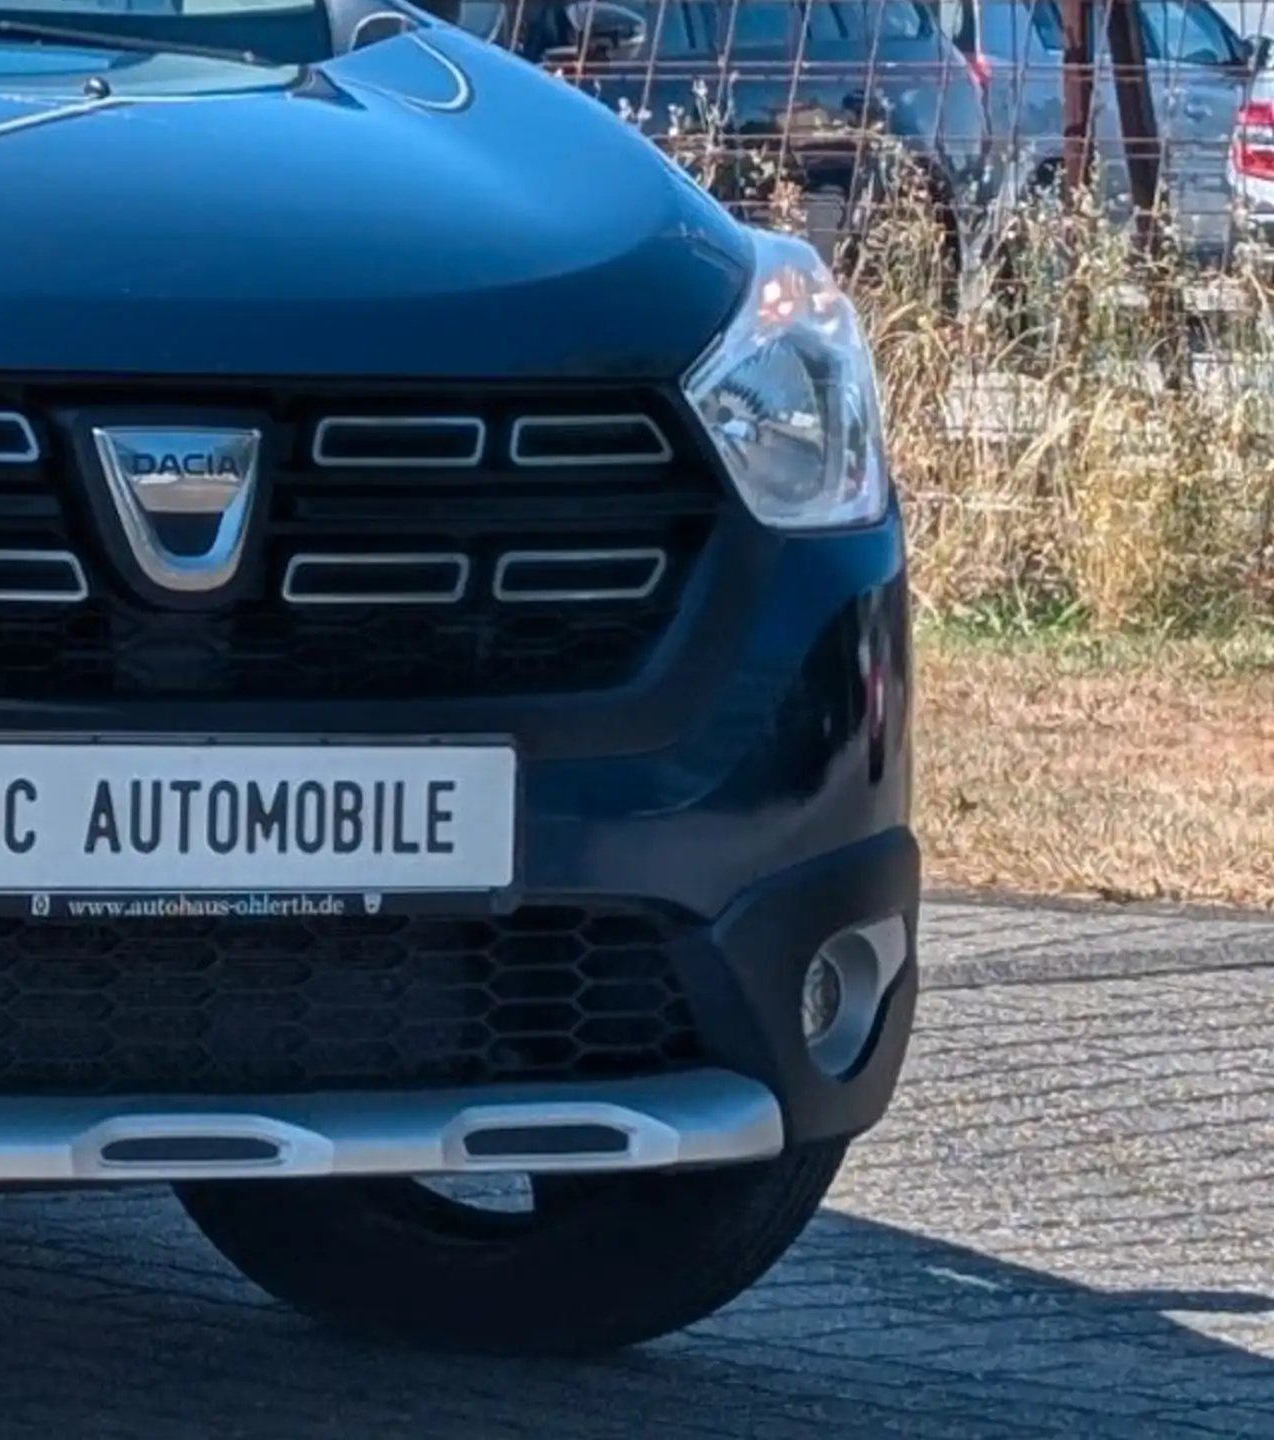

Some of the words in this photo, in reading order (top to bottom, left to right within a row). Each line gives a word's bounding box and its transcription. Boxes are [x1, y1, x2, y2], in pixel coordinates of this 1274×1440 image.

[131, 452, 241, 477] DACIA
[83, 779, 457, 855] AUTOMOBILE
[67, 893, 345, 917] www.autohaus-ohlerth.de
